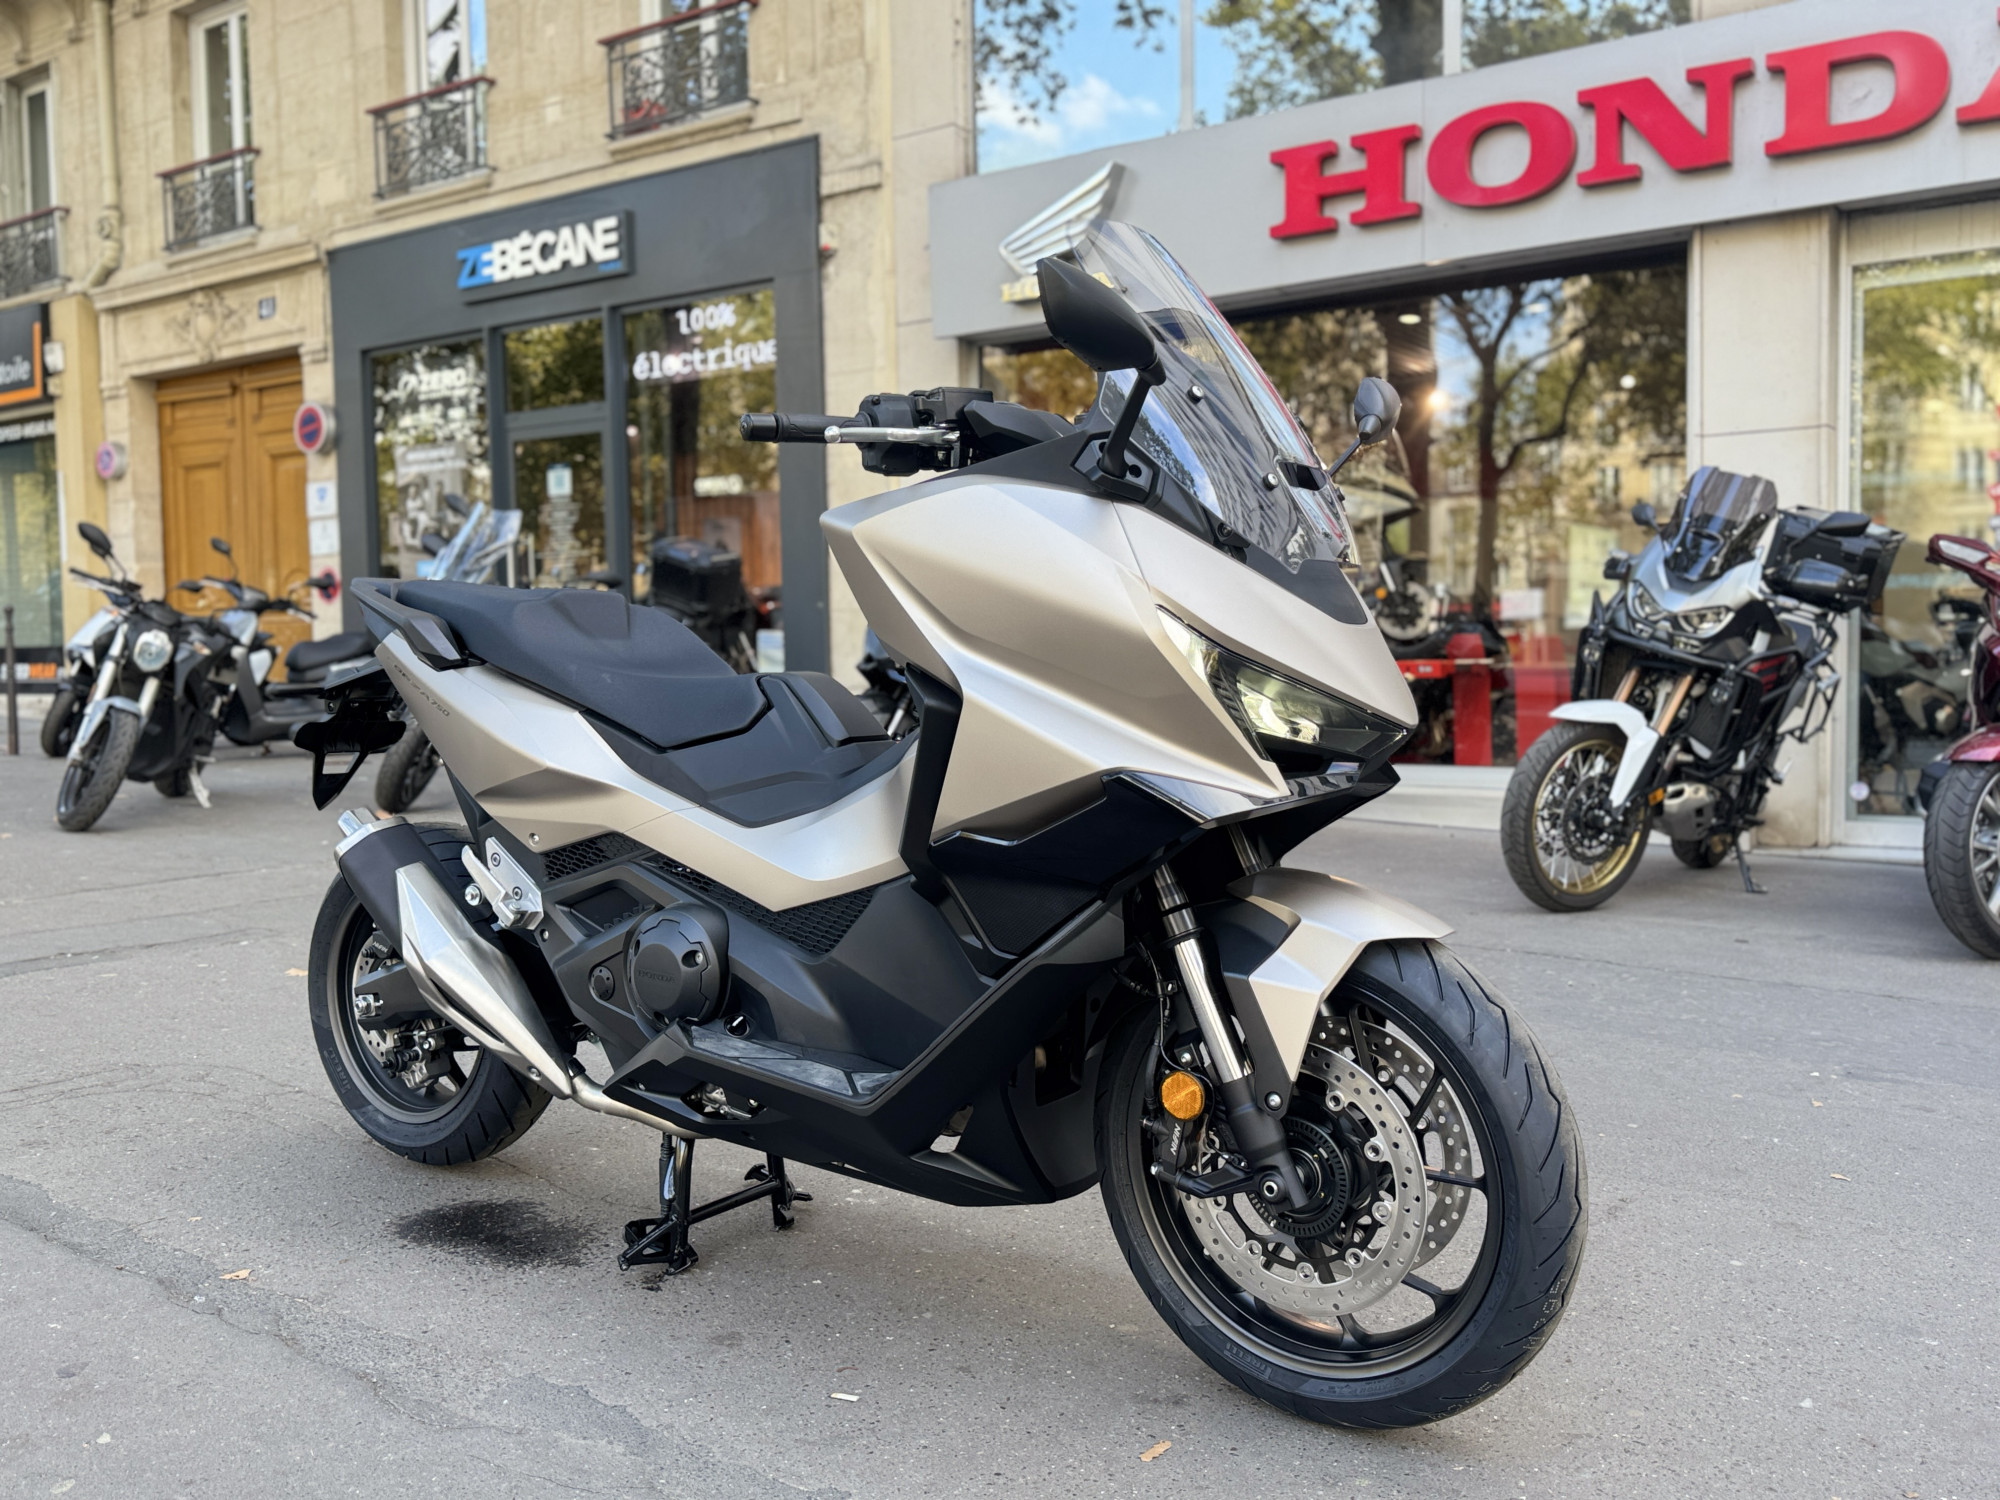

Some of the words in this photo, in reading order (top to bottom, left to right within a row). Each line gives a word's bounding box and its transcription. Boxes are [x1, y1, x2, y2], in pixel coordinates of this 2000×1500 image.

[1268, 6, 2000, 241] HOND
[456, 215, 620, 290] ZEBÉCANE
[675, 302, 737, 335] 100%
[632, 338, 778, 381] électrique
